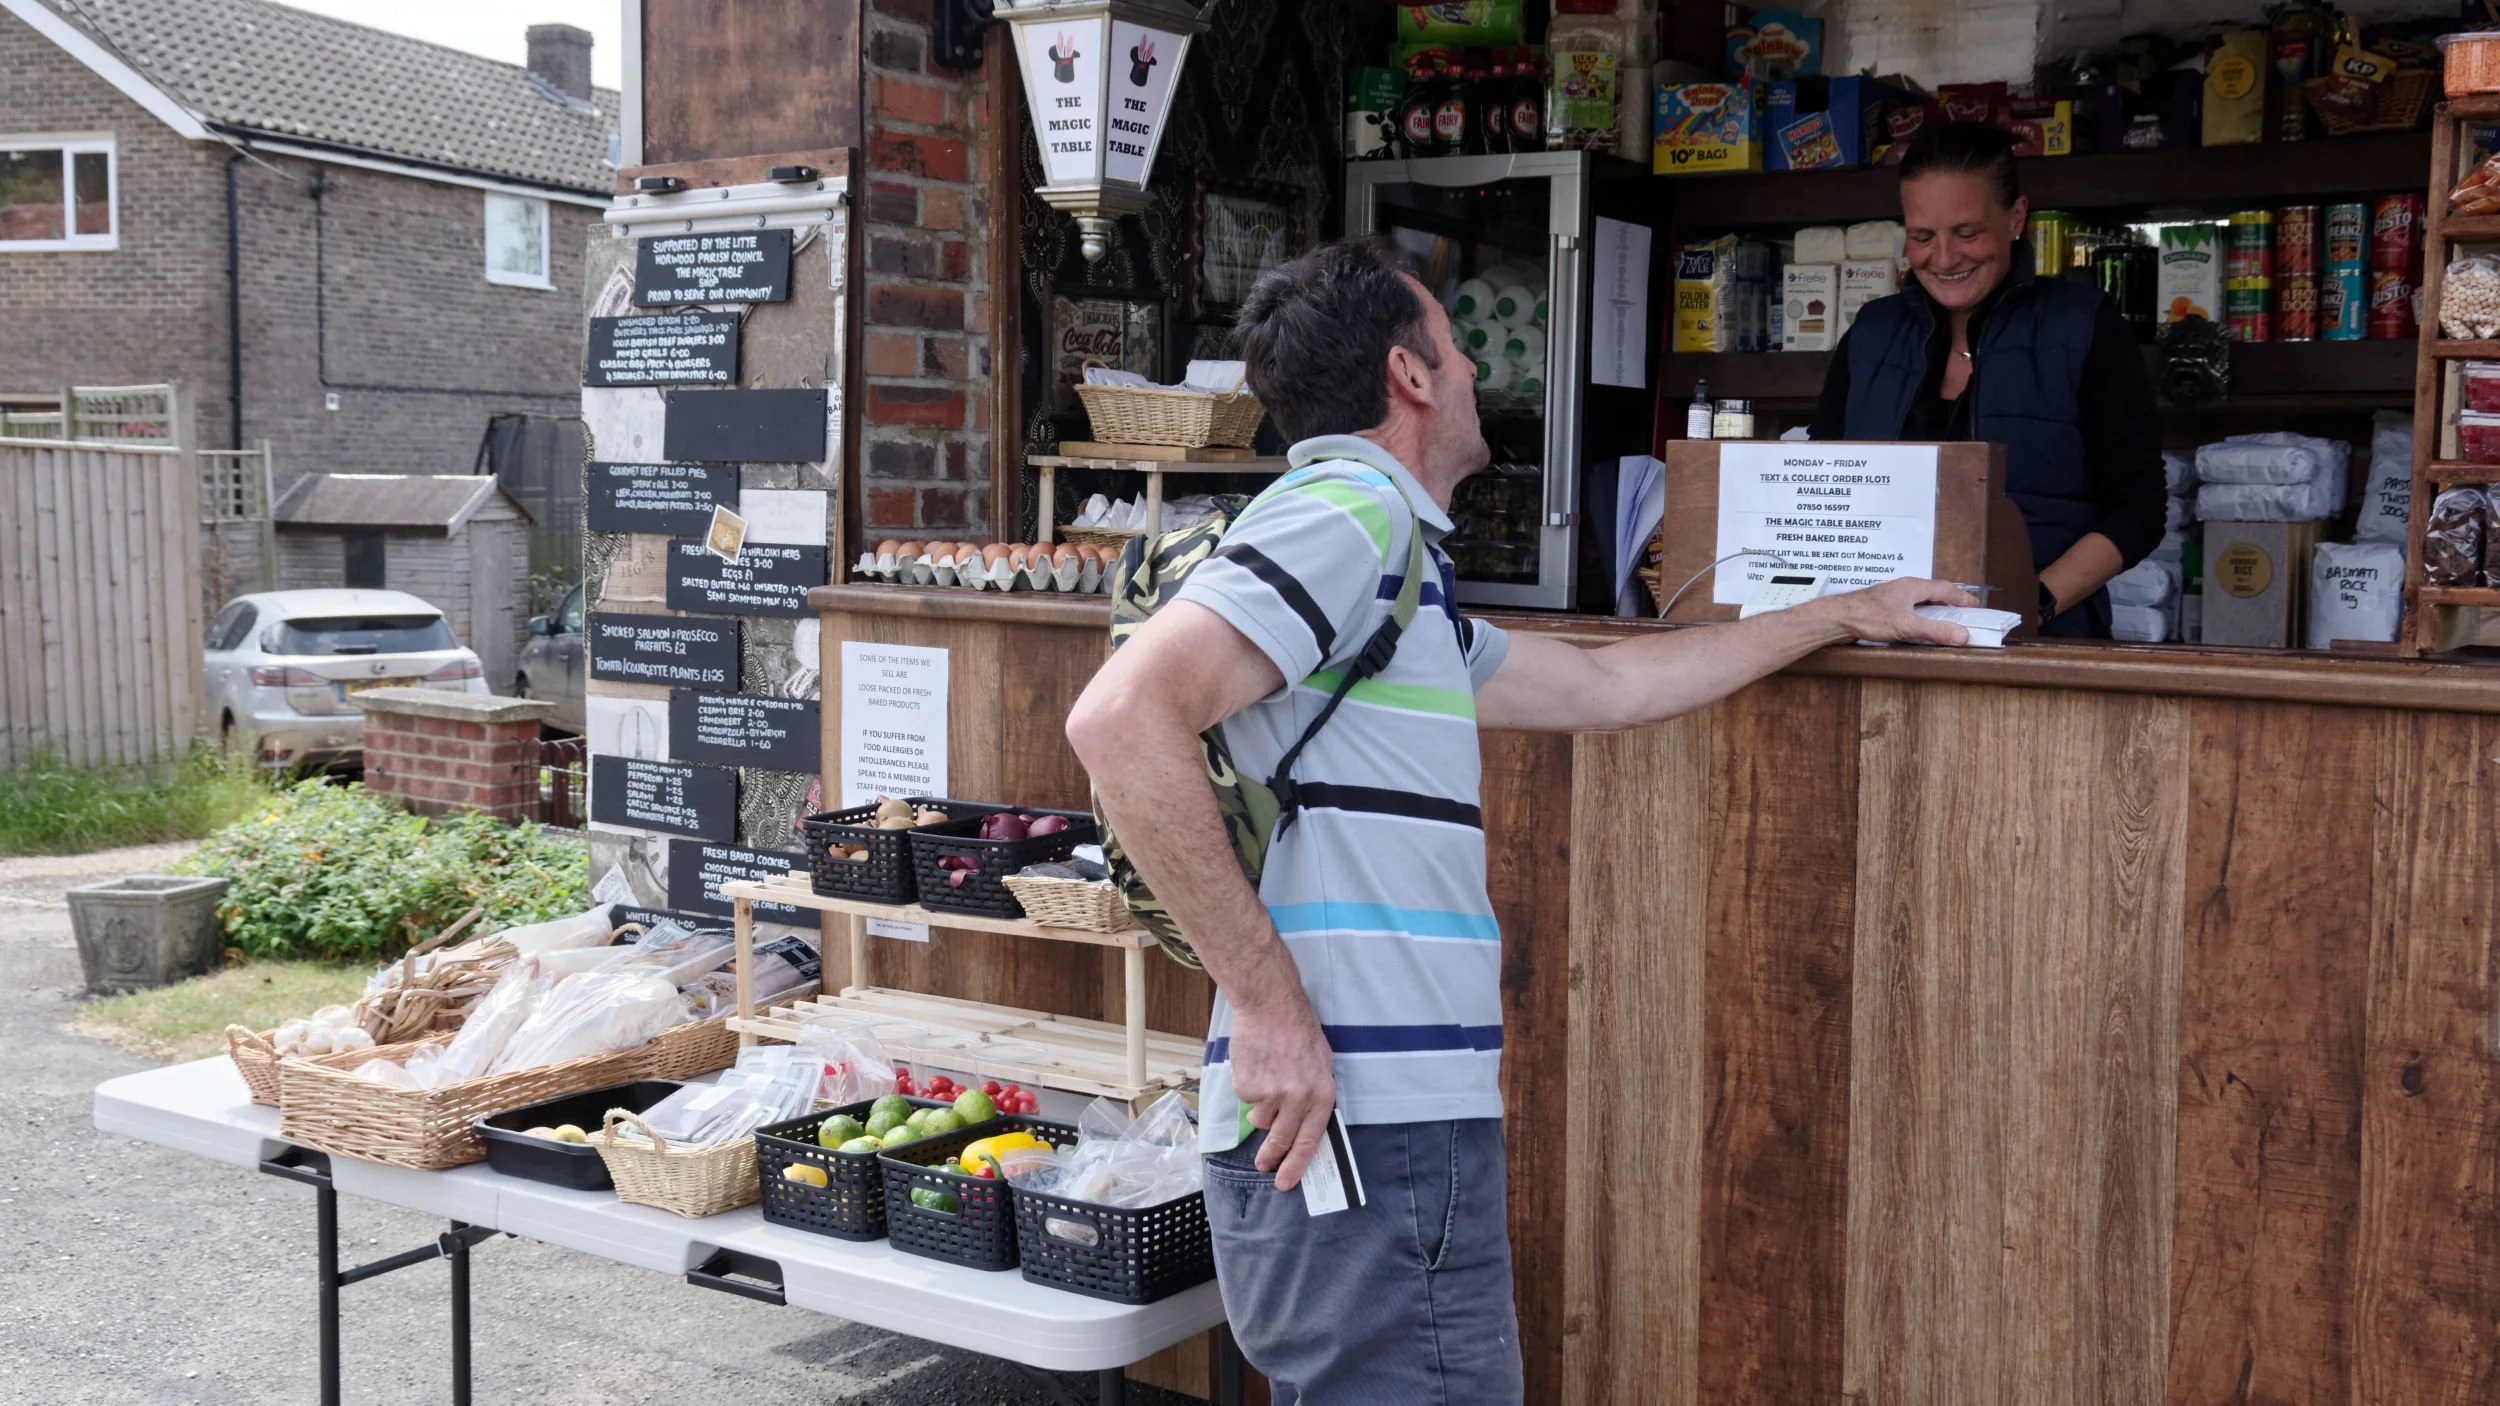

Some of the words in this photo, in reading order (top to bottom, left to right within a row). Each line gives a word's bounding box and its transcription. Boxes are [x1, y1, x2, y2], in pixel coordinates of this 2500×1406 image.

[2347, 59, 2374, 74] KP
[1055, 96, 1082, 108] THE
[1124, 98, 1147, 112] THE
[1048, 118, 1091, 131] MAGIC
[1112, 118, 1150, 135] MAGIC
[1413, 117, 1430, 128] FAIR
[1438, 114, 1459, 127] FAIRY
[1051, 141, 1092, 153] TABLE
[1109, 140, 1145, 157] TABLE
[1697, 148, 1728, 160] BAGS
[2374, 212, 2412, 236] BISTO
[652, 239, 698, 254] SUPPORTED
[701, 238, 713, 250] BY
[714, 237, 731, 250] THE
[698, 251, 729, 264] PARISH
[732, 250, 764, 263] COUNCIL
[676, 267, 690, 278] THE
[692, 266, 715, 280] MAGIC
[714, 266, 744, 278] TABLE
[699, 276, 719, 288] SHOP
[648, 290, 672, 302] PROUD
[674, 290, 683, 300] TO
[684, 288, 705, 300] SERVE
[709, 288, 724, 300] OUR
[725, 285, 772, 300] COMMUNITY
[1680, 291, 1710, 300] GOLDEN
[2372, 284, 2410, 308] BISTO
[1680, 300, 1710, 310] CASTER
[1784, 459, 1824, 467] MONDAY
[1834, 460, 1868, 468] FRIDAY
[1760, 474, 1780, 482] TEXT
[1782, 474, 1790, 482] &
[1792, 474, 1830, 483] COLLECT
[1832, 475, 1863, 483] ORDER
[1865, 475, 1890, 484] SLOTS
[2384, 477, 2411, 491] PAST
[1797, 487, 1852, 496] AVAILLABLE
[1824, 504, 1850, 512] 165917
[1766, 518, 1782, 526] THE
[1784, 518, 1814, 527] MAGIC
[1816, 519, 1843, 528] TABLE
[1846, 520, 1882, 528] BAKERY
[1776, 534, 1804, 542] FRESH
[1806, 534, 1836, 542] BAKED
[1838, 535, 1868, 544] BREAD
[1792, 550, 1810, 558] WILL
[722, 568, 743, 580] EGGS
[1800, 564, 1852, 572] PRE-ORDERED
[1865, 566, 1895, 574] MIDDAY
[2326, 566, 2378, 580] BASMATI
[682, 577, 709, 588] SALTED
[710, 580, 736, 590] BUTTER
[2340, 580, 2368, 592] RICE
[706, 590, 726, 602] SEMI
[728, 593, 762, 605] SKIMMED
[762, 597, 780, 607] MILK
[602, 624, 634, 638] SMOKED
[636, 627, 670, 640] SALMON
[676, 630, 718, 642] PROSECCO
[634, 640, 672, 653] PARFAITS
[674, 642, 687, 655] £2
[860, 654, 876, 662] SOME
[888, 656, 900, 664] THE
[900, 657, 920, 666] ITEMS
[921, 658, 931, 667] WE
[670, 666, 700, 680] PLANTS
[882, 670, 894, 678] SELL
[896, 670, 908, 678] ARE
[858, 684, 876, 692] LOOSE
[878, 685, 902, 694] PACKED
[902, 687, 912, 696] OR
[912, 688, 932, 697] FRESH
[868, 698, 888, 706] BAKED
[889, 699, 920, 710] PRODUCTS
[869, 730, 882, 738] YOU
[884, 732, 906, 740] SUFFER
[906, 734, 926, 742] FROM
[864, 743, 880, 752] FOOD
[882, 745, 913, 755] ALLERGIES
[914, 748, 924, 756] OR
[858, 756, 906, 768] INTOLLERANCES
[908, 761, 929, 770] PLEASE
[858, 769, 876, 778] SPEAK
[888, 772, 892, 780] A
[894, 773, 920, 783] MEMBER
[922, 776, 930, 784] OF
[856, 782, 874, 790] STAFF
[876, 784, 887, 792] FOR
[889, 786, 906, 795] MORE
[908, 788, 932, 798] DETAILS
[702, 847, 728, 860] FRESH
[730, 850, 755, 863] BAKED
[757, 855, 790, 869] COOKIES
[704, 862, 746, 877] CHOCOLATE
[626, 912, 650, 923] WHITE
